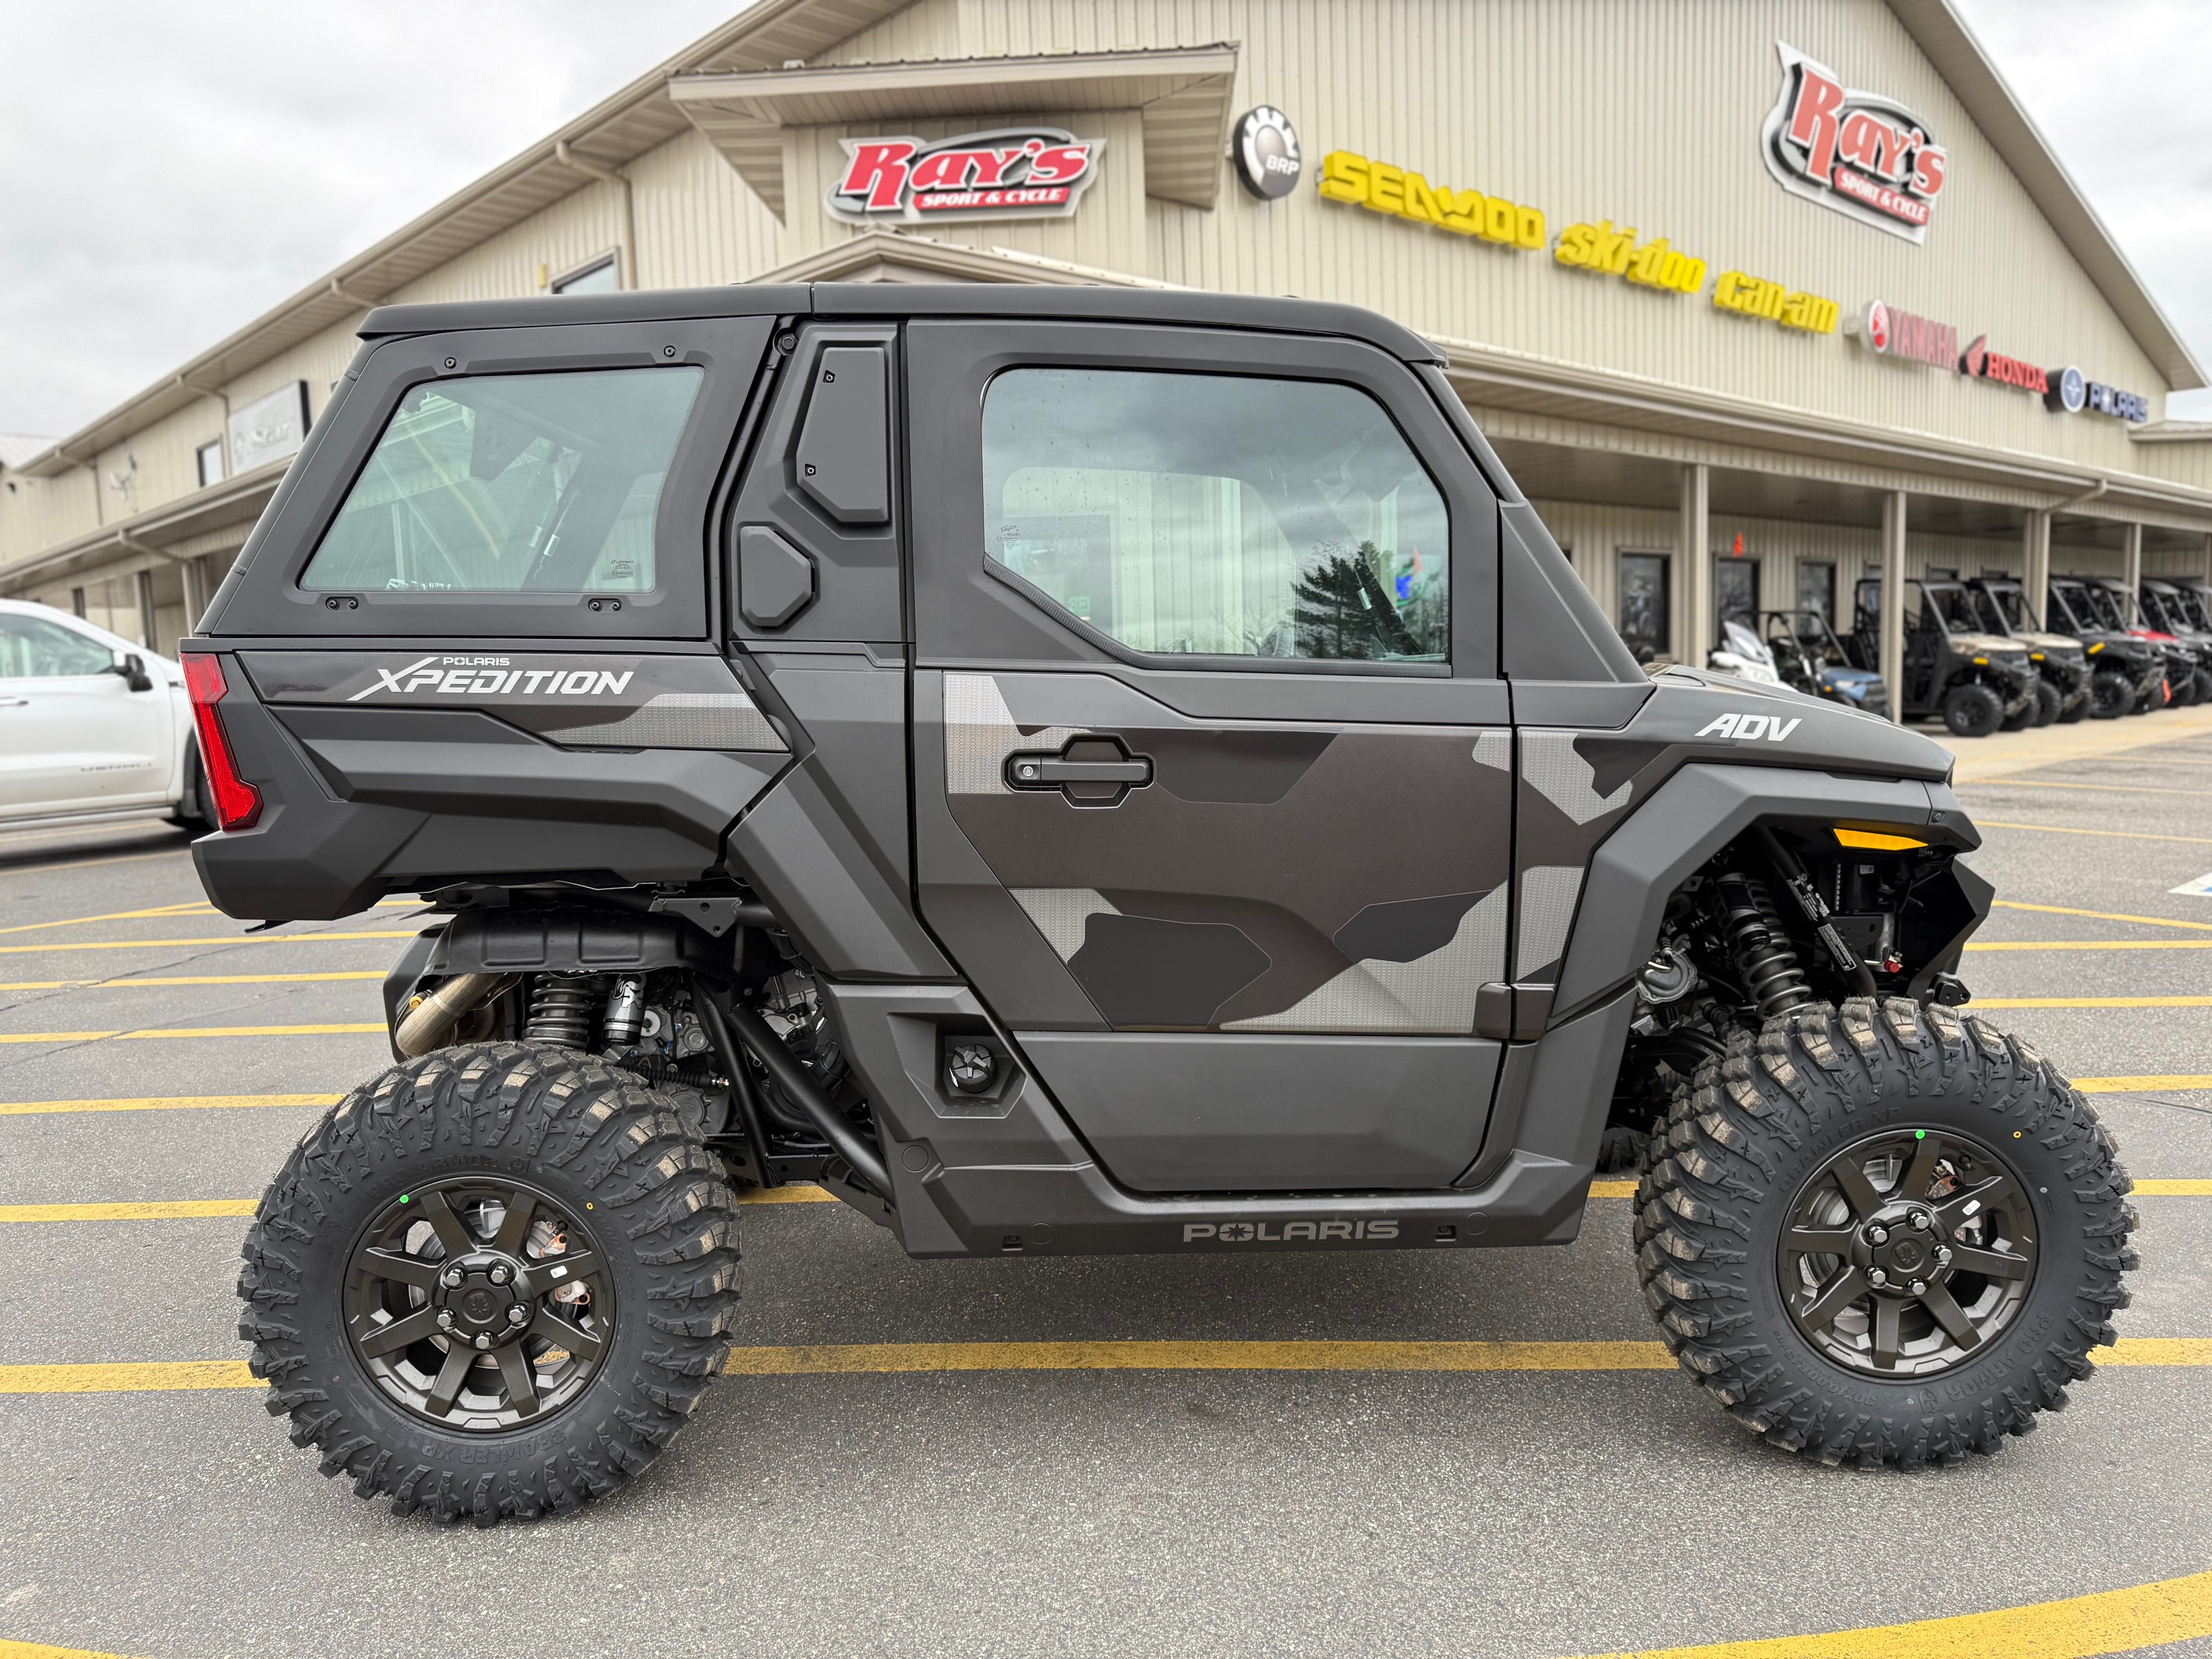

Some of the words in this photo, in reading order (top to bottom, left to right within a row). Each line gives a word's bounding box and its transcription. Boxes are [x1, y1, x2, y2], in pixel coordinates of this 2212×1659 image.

[1266, 154, 1300, 175] BRP
[921, 192, 984, 207] SPORT
[985, 191, 1002, 204] &
[1005, 188, 1064, 202] CYCLE
[1840, 170, 1881, 201] SPORT
[1880, 191, 1891, 207] &
[1892, 196, 1927, 222] CYCLE
[1888, 307, 1959, 371] YAMAHA
[1987, 352, 2049, 393] HONDA
[2089, 380, 2148, 424] POLARIS
[345, 657, 634, 702] XPEDITION
[443, 657, 510, 666] POLARIS
[1694, 713, 1803, 741] ADV
[1778, 1117, 1863, 1193] CRAWLER
[1183, 1219, 1400, 1242] POLARIS
[2016, 1312, 2053, 1355] PRO
[1944, 1352, 2020, 1402] ARMOR
[421, 1441, 456, 1462] XP
[460, 1427, 567, 1464] CRAWLER
